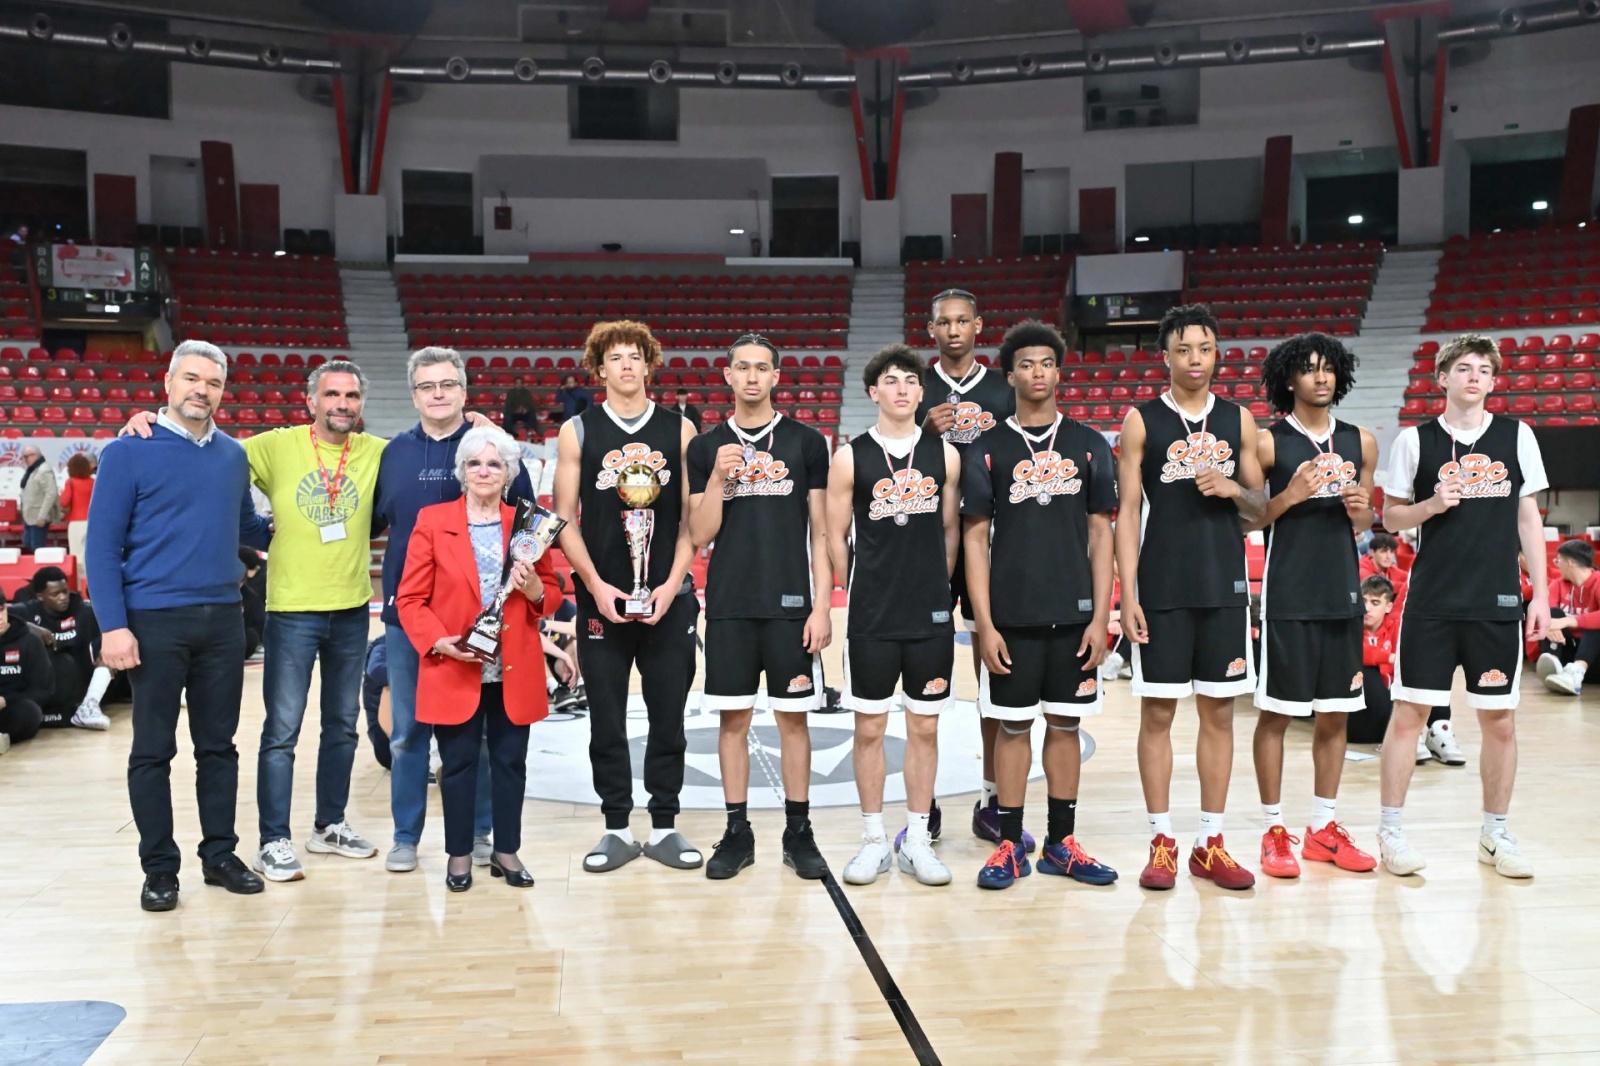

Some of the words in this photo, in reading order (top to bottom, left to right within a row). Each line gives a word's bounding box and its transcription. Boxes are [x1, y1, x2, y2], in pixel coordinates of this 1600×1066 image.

[37, 247, 48, 276] BAR
[140, 252, 150, 280] BAR
[1088, 296, 1097, 307] 4
[952, 401, 997, 431] BC
[722, 479, 795, 501] Basketball
